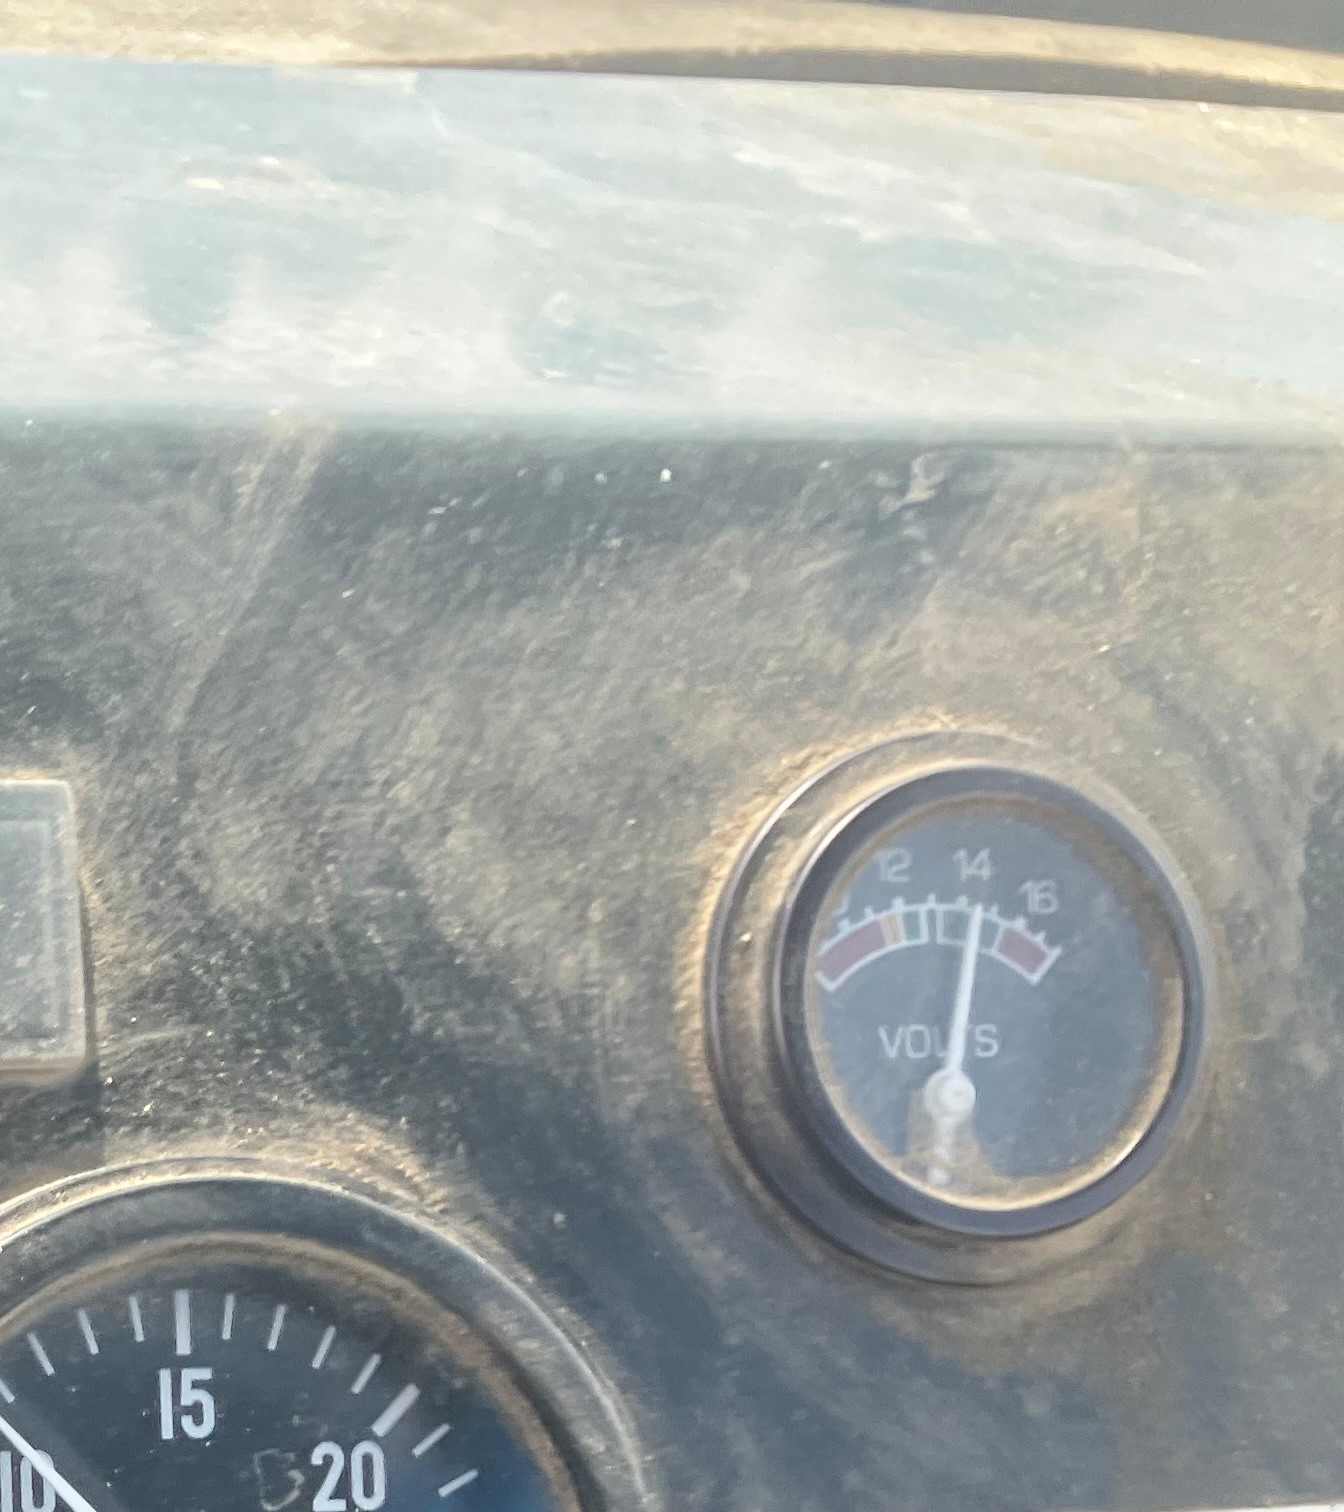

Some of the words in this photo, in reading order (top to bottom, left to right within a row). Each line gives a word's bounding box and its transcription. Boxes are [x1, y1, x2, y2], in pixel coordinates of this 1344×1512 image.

[953, 848, 992, 882] 14
[878, 1022, 1000, 1059] VOLS
[160, 1368, 217, 1440] 15
[311, 1440, 386, 1512] 20
